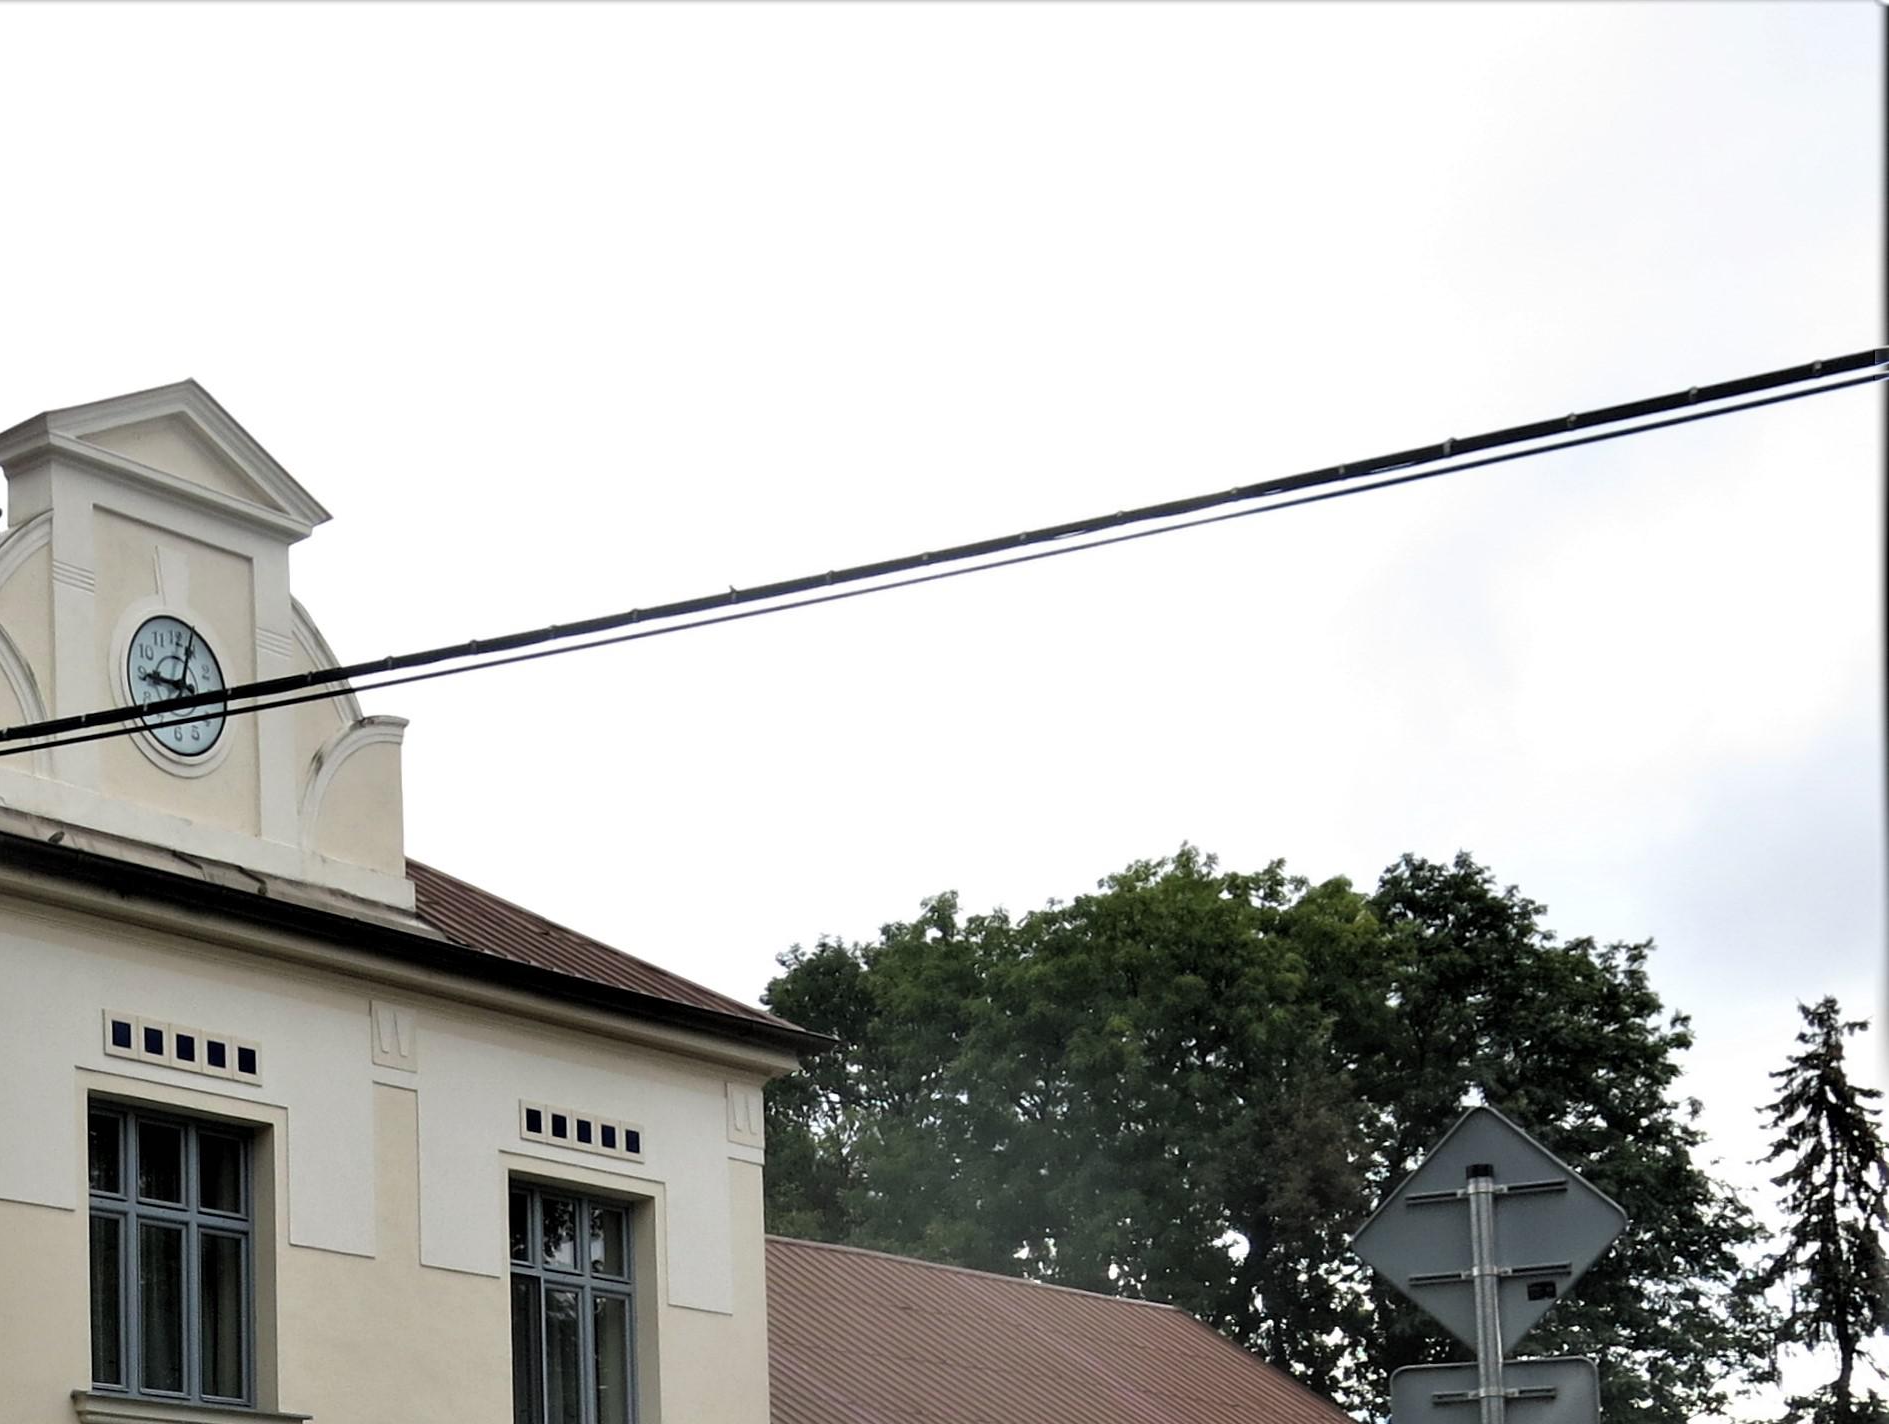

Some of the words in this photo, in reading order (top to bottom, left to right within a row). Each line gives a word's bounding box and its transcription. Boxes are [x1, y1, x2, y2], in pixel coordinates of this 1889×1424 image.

[152, 631, 164, 648] 11
[169, 629, 183, 647] 12
[138, 643, 154, 661] 10
[137, 665, 147, 681] 9
[200, 664, 210, 680] 2
[174, 726, 183, 742] 6
[190, 725, 200, 741] 5
